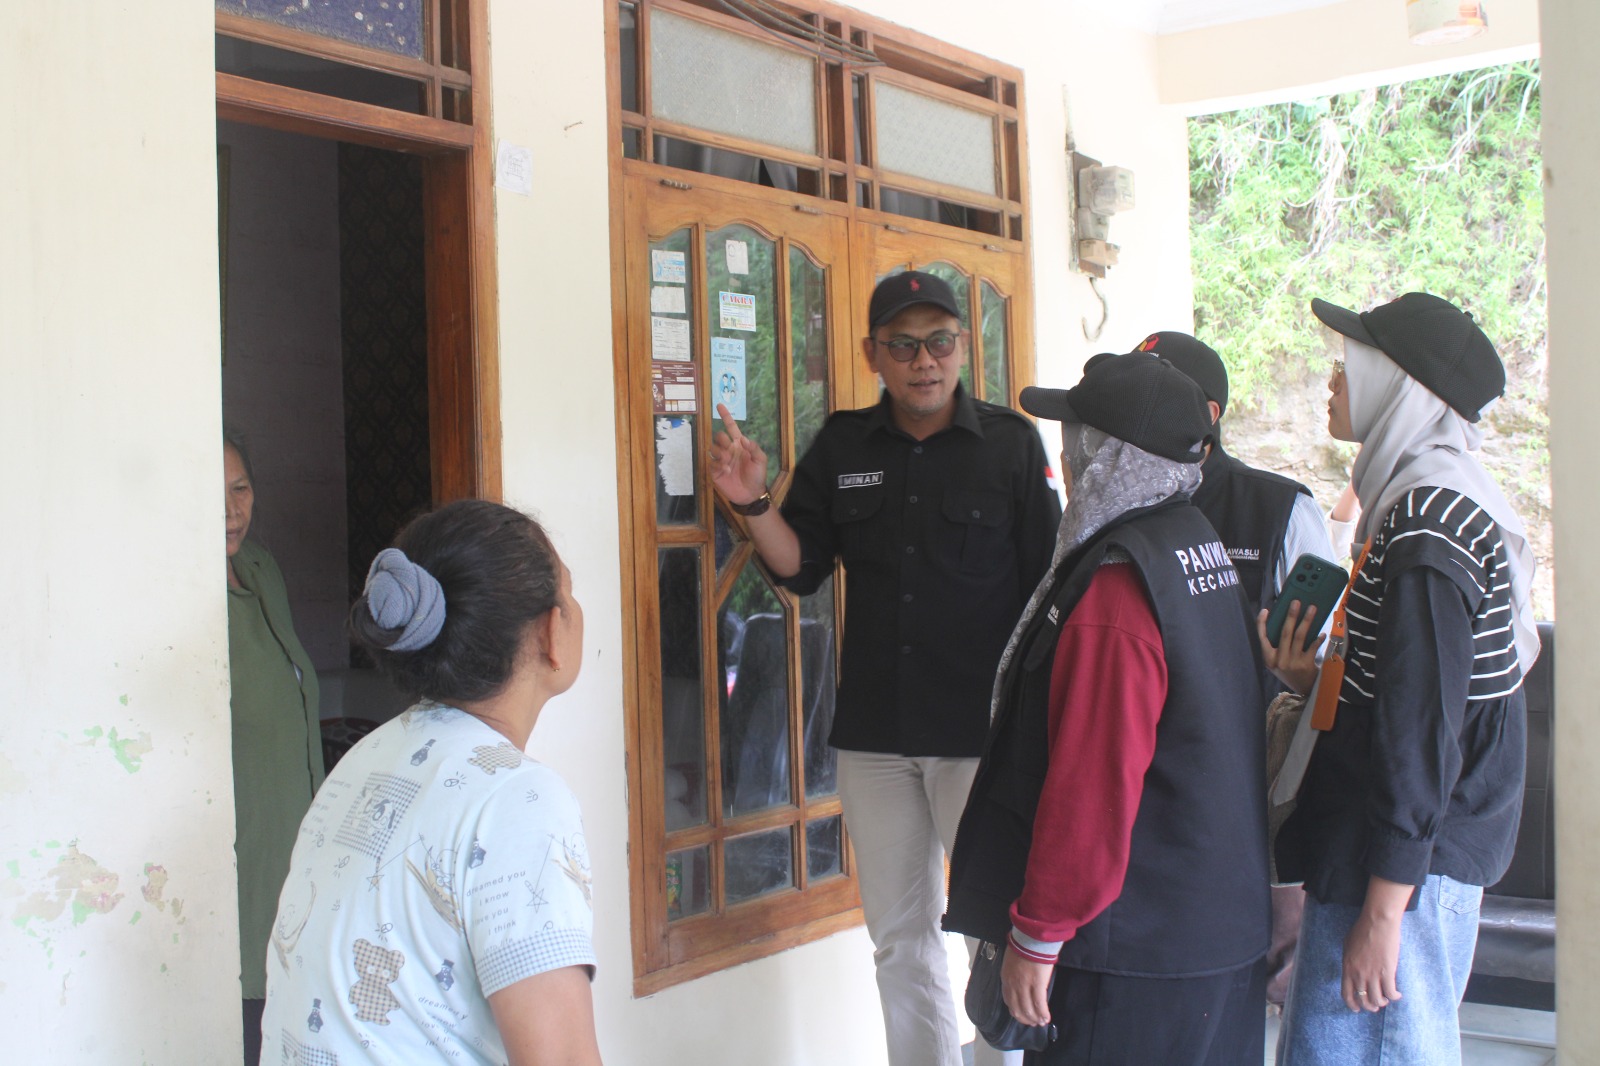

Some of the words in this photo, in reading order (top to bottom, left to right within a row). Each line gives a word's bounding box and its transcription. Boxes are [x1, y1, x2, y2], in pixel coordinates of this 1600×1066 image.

[722, 294, 752, 305] CAKRA
[466, 876, 504, 897] dreamed
[507, 870, 526, 882] you
[485, 891, 510, 903] know
[492, 907, 509, 919] you
[494, 920, 516, 934] think
